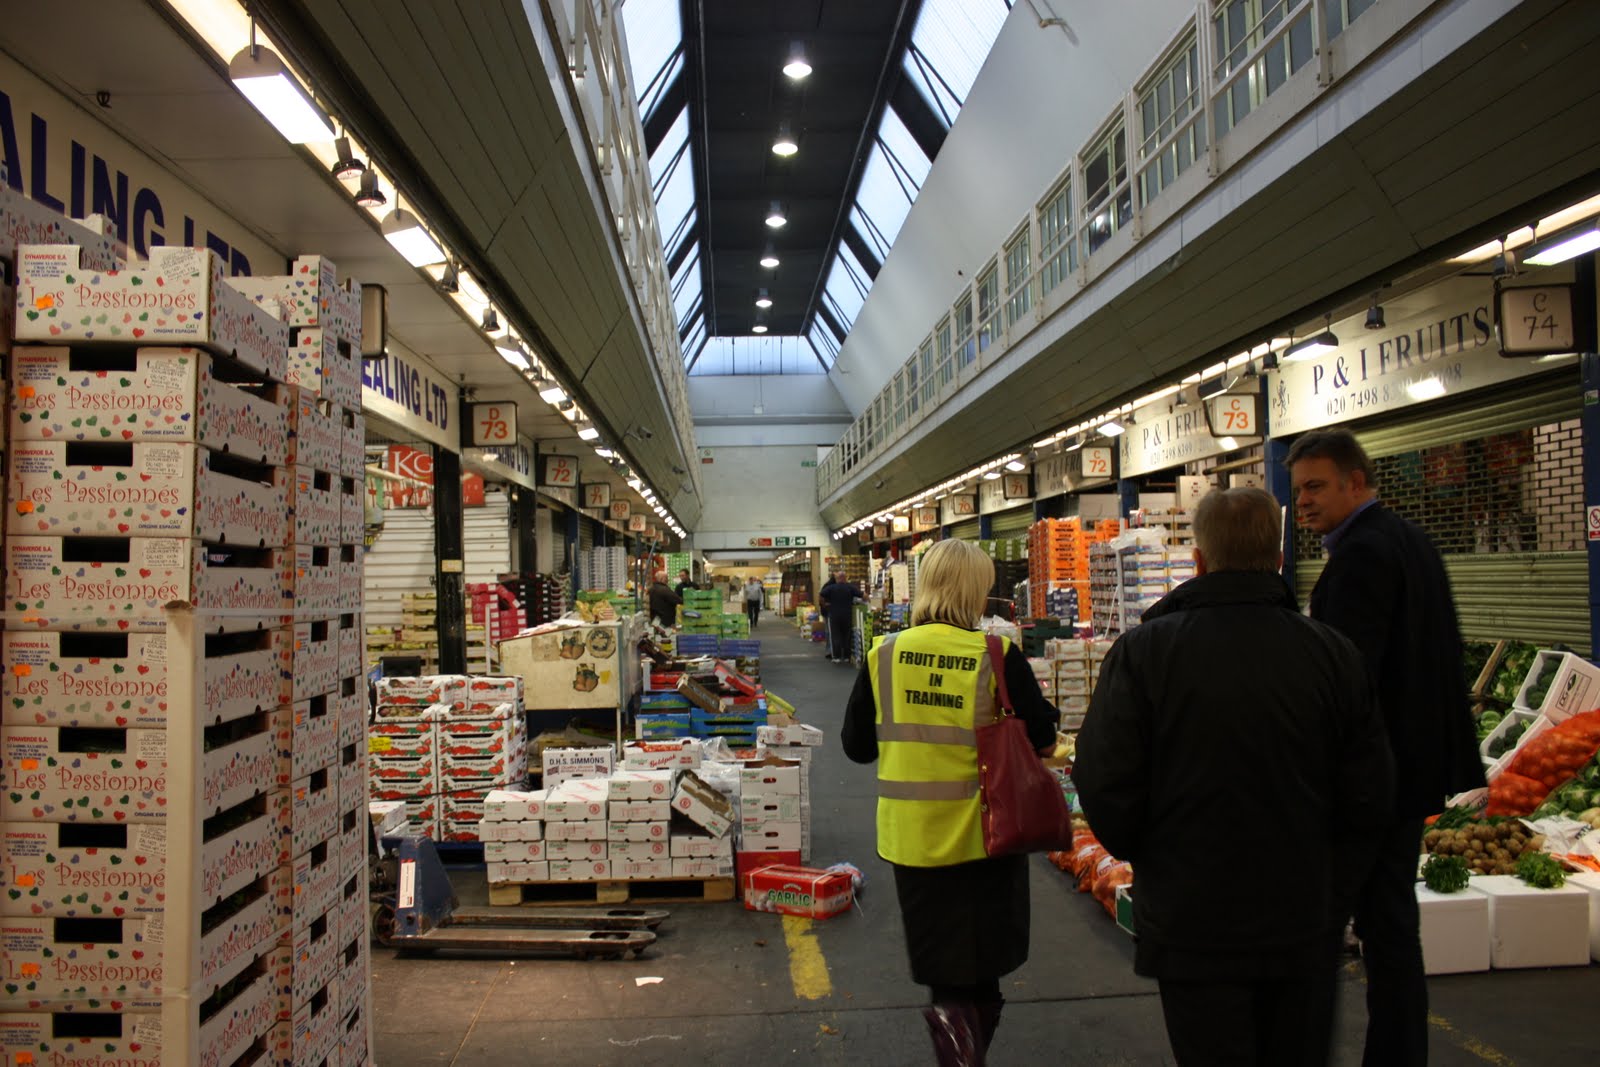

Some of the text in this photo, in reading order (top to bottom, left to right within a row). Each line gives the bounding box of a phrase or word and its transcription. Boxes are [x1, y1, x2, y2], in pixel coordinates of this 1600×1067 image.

[74, 284, 196, 308] Passionnés
[1533, 292, 1547, 312] C
[1523, 314, 1558, 340] 74
[1313, 364, 1324, 395] P
[1333, 356, 1350, 389] &
[1360, 348, 1367, 381] I
[1378, 305, 1491, 376] FRUITS
[65, 385, 183, 411] Passionnés
[425, 378, 448, 431] LTD
[1231, 400, 1240, 411] C
[1326, 388, 1378, 416] 020 7498
[489, 408, 500, 420] D
[1224, 411, 1249, 429] 73
[480, 421, 508, 440] 73
[1143, 428, 1149, 450] P
[1153, 424, 1162, 446] &
[393, 449, 433, 478] KG
[558, 460, 567, 468] D
[1094, 450, 1100, 459] C
[552, 469, 571, 482] 72
[1089, 460, 1107, 472] 72
[16, 479, 179, 505] Les Passionnés
[590, 493, 603, 504] 71
[1012, 484, 1023, 494] 71
[959, 503, 970, 511] 70
[15, 575, 178, 600] Les Passionnés
[899, 651, 977, 671] FRUIT BUYER
[15, 674, 48, 695] Les
[928, 673, 943, 687] IN
[905, 690, 964, 709] TRAINING
[550, 757, 605, 766] D.H.S. SIMMONS
[12, 768, 46, 789] Les
[768, 889, 812, 906] GARLIC
